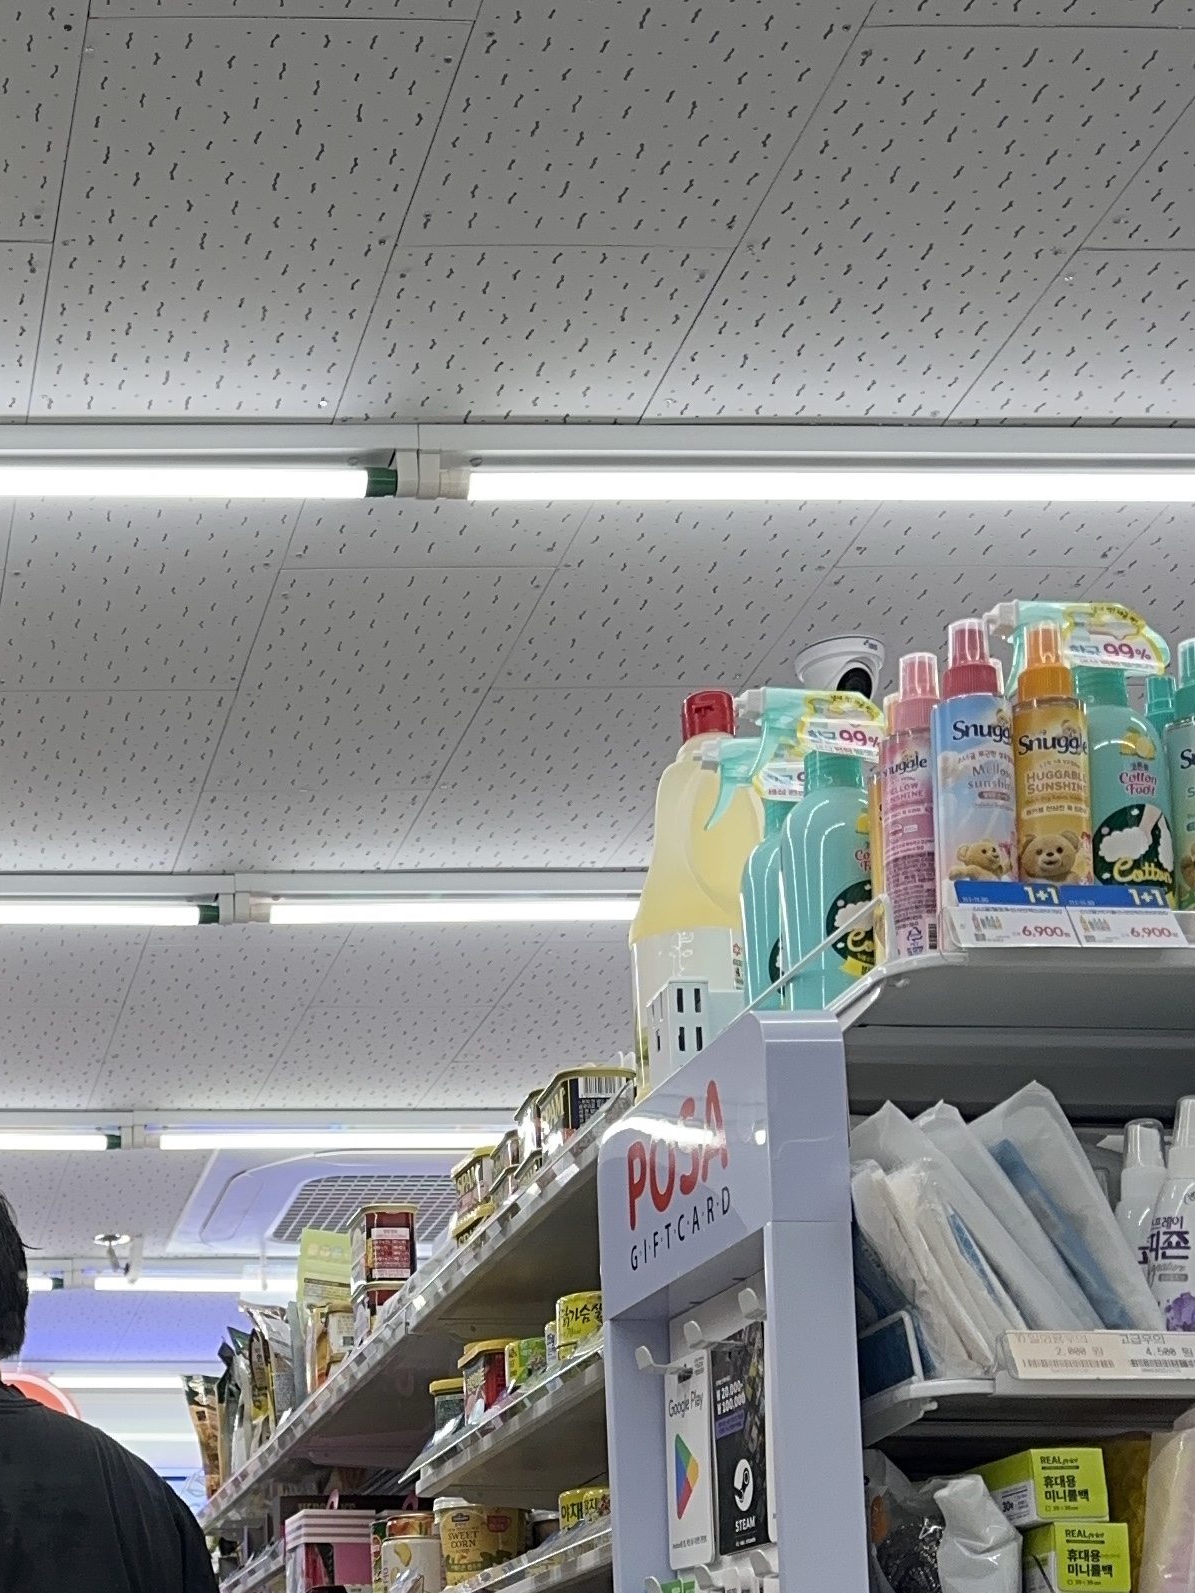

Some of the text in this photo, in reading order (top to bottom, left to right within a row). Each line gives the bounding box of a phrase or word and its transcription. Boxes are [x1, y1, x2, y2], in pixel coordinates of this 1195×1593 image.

[1103, 643, 1152, 660] 99%
[952, 719, 1013, 746] Snugg
[1018, 732, 1088, 756] Snuggle
[1119, 771, 1158, 786] Cotton
[1023, 886, 1060, 904] 1+1
[1128, 888, 1164, 906] 1+1
[1021, 925, 1063, 938] 6,900
[1130, 926, 1172, 938] 6,900
[627, 1079, 730, 1231] POSA
[668, 1390, 704, 1419] Google Play
[1043, 1475, 1077, 1489] 휴대용
[735, 1515, 756, 1533] STEAM
[448, 1530, 478, 1542] SWEET
[450, 1539, 477, 1550] CORN
[1066, 1549, 1101, 1563] 휴대용
